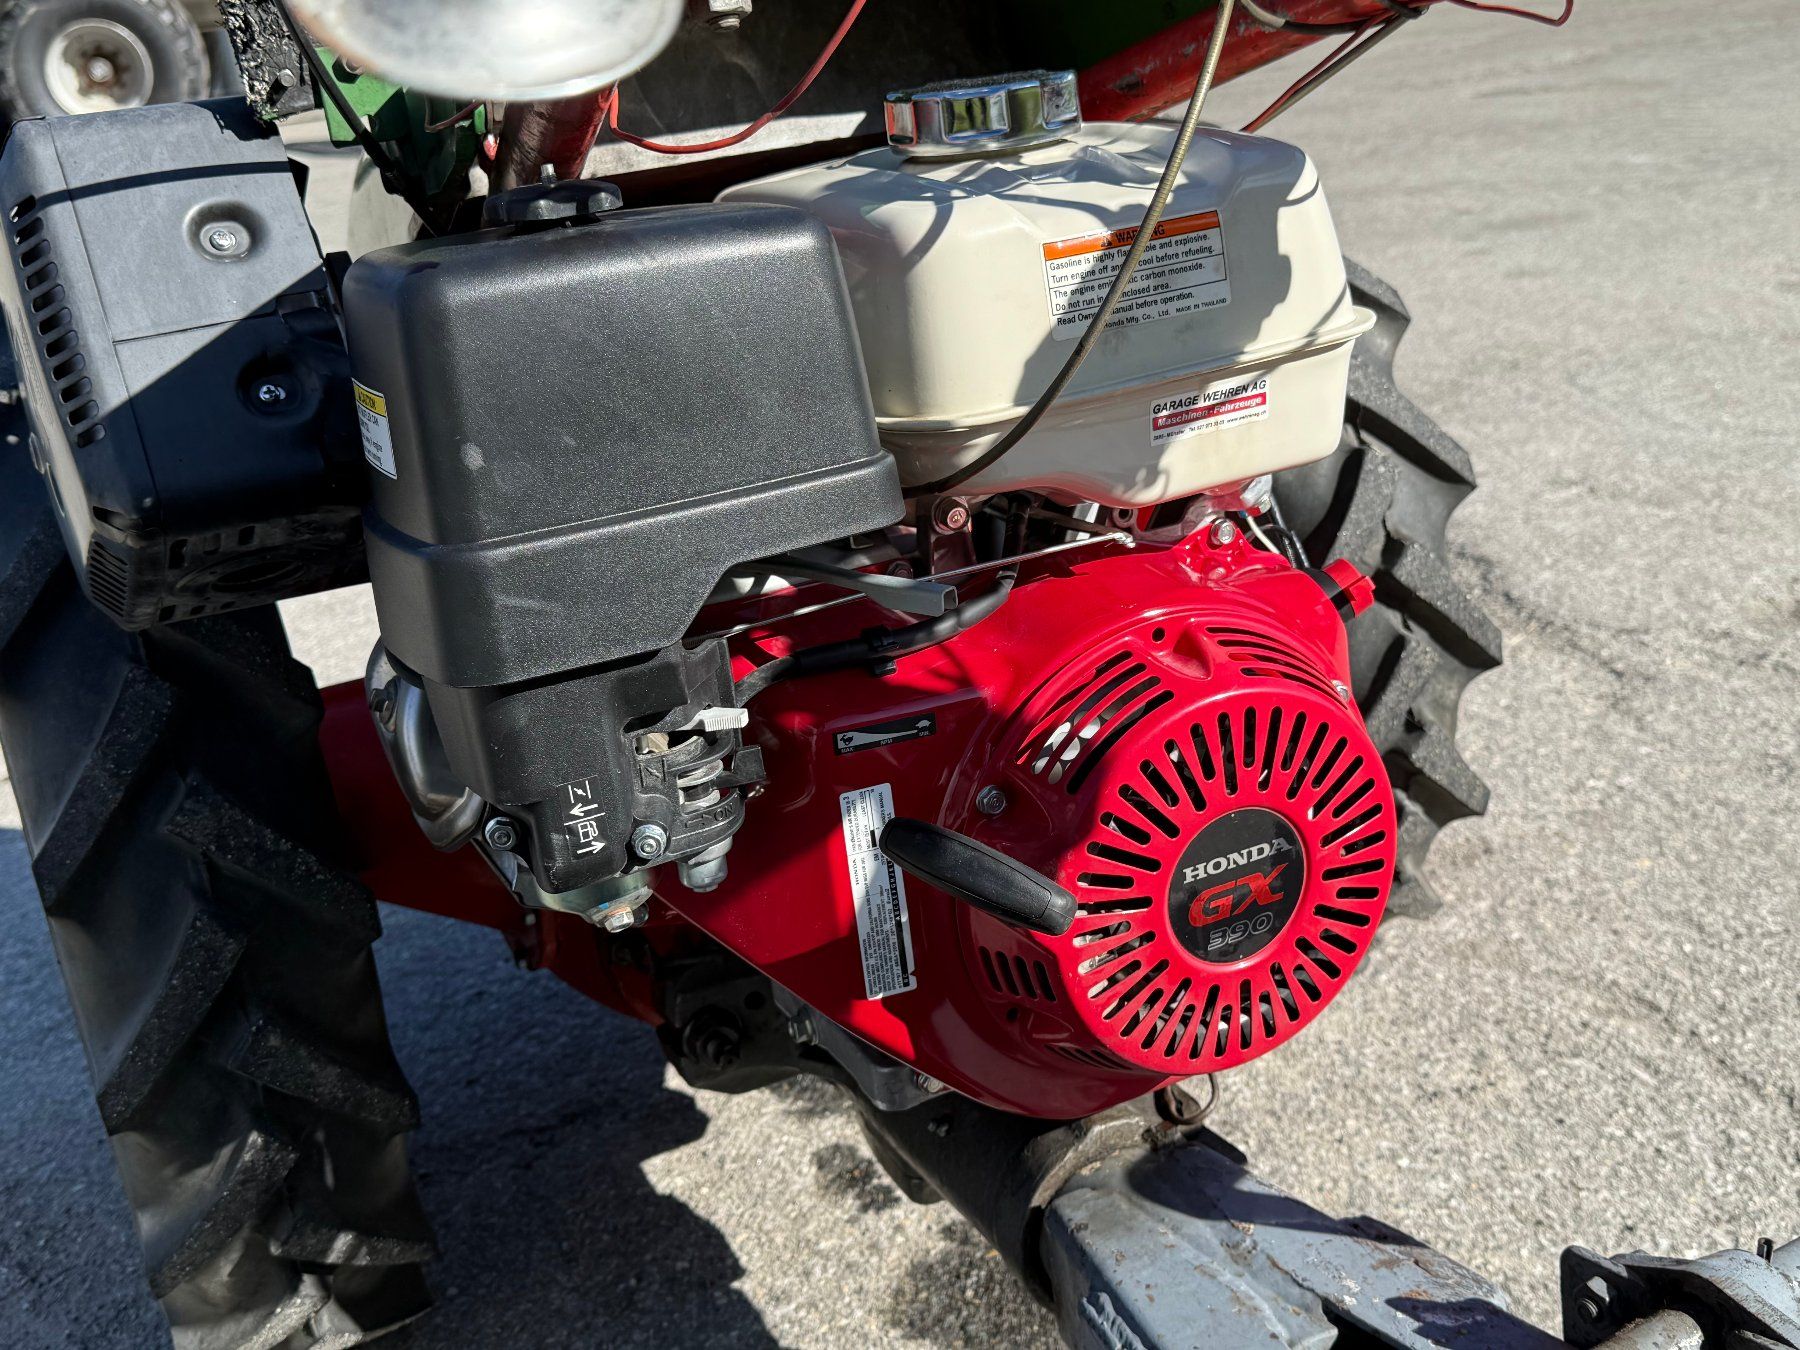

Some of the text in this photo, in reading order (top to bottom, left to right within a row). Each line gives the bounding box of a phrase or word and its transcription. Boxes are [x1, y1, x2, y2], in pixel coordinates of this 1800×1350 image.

[1049, 257, 1082, 271] Gasoline
[1084, 256, 1091, 264] is
[1092, 251, 1116, 264] highly
[1158, 239, 1173, 250] and
[1174, 232, 1210, 248] explosive.
[1051, 244, 1215, 284] Turn engine off an cool before refueling.
[1054, 289, 1068, 299] The
[1070, 283, 1095, 297] engine
[1140, 269, 1166, 281] carbon
[1167, 261, 1205, 276] monoxide.
[1055, 281, 1171, 312] Do not run in nclosed area.
[1057, 315, 1077, 326] Read
[1110, 302, 1134, 315] anual
[1135, 298, 1158, 310] before
[1159, 290, 1195, 306] operation.
[1125, 315, 1140, 325] Mfg.
[1175, 305, 1192, 313] MADE
[1201, 298, 1227, 308] THAILAND
[1152, 380, 1267, 414] GARAGE WEHREN AG
[1182, 837, 1293, 885] HONDA
[1188, 863, 1289, 927] GX
[1207, 911, 1274, 951] 390
